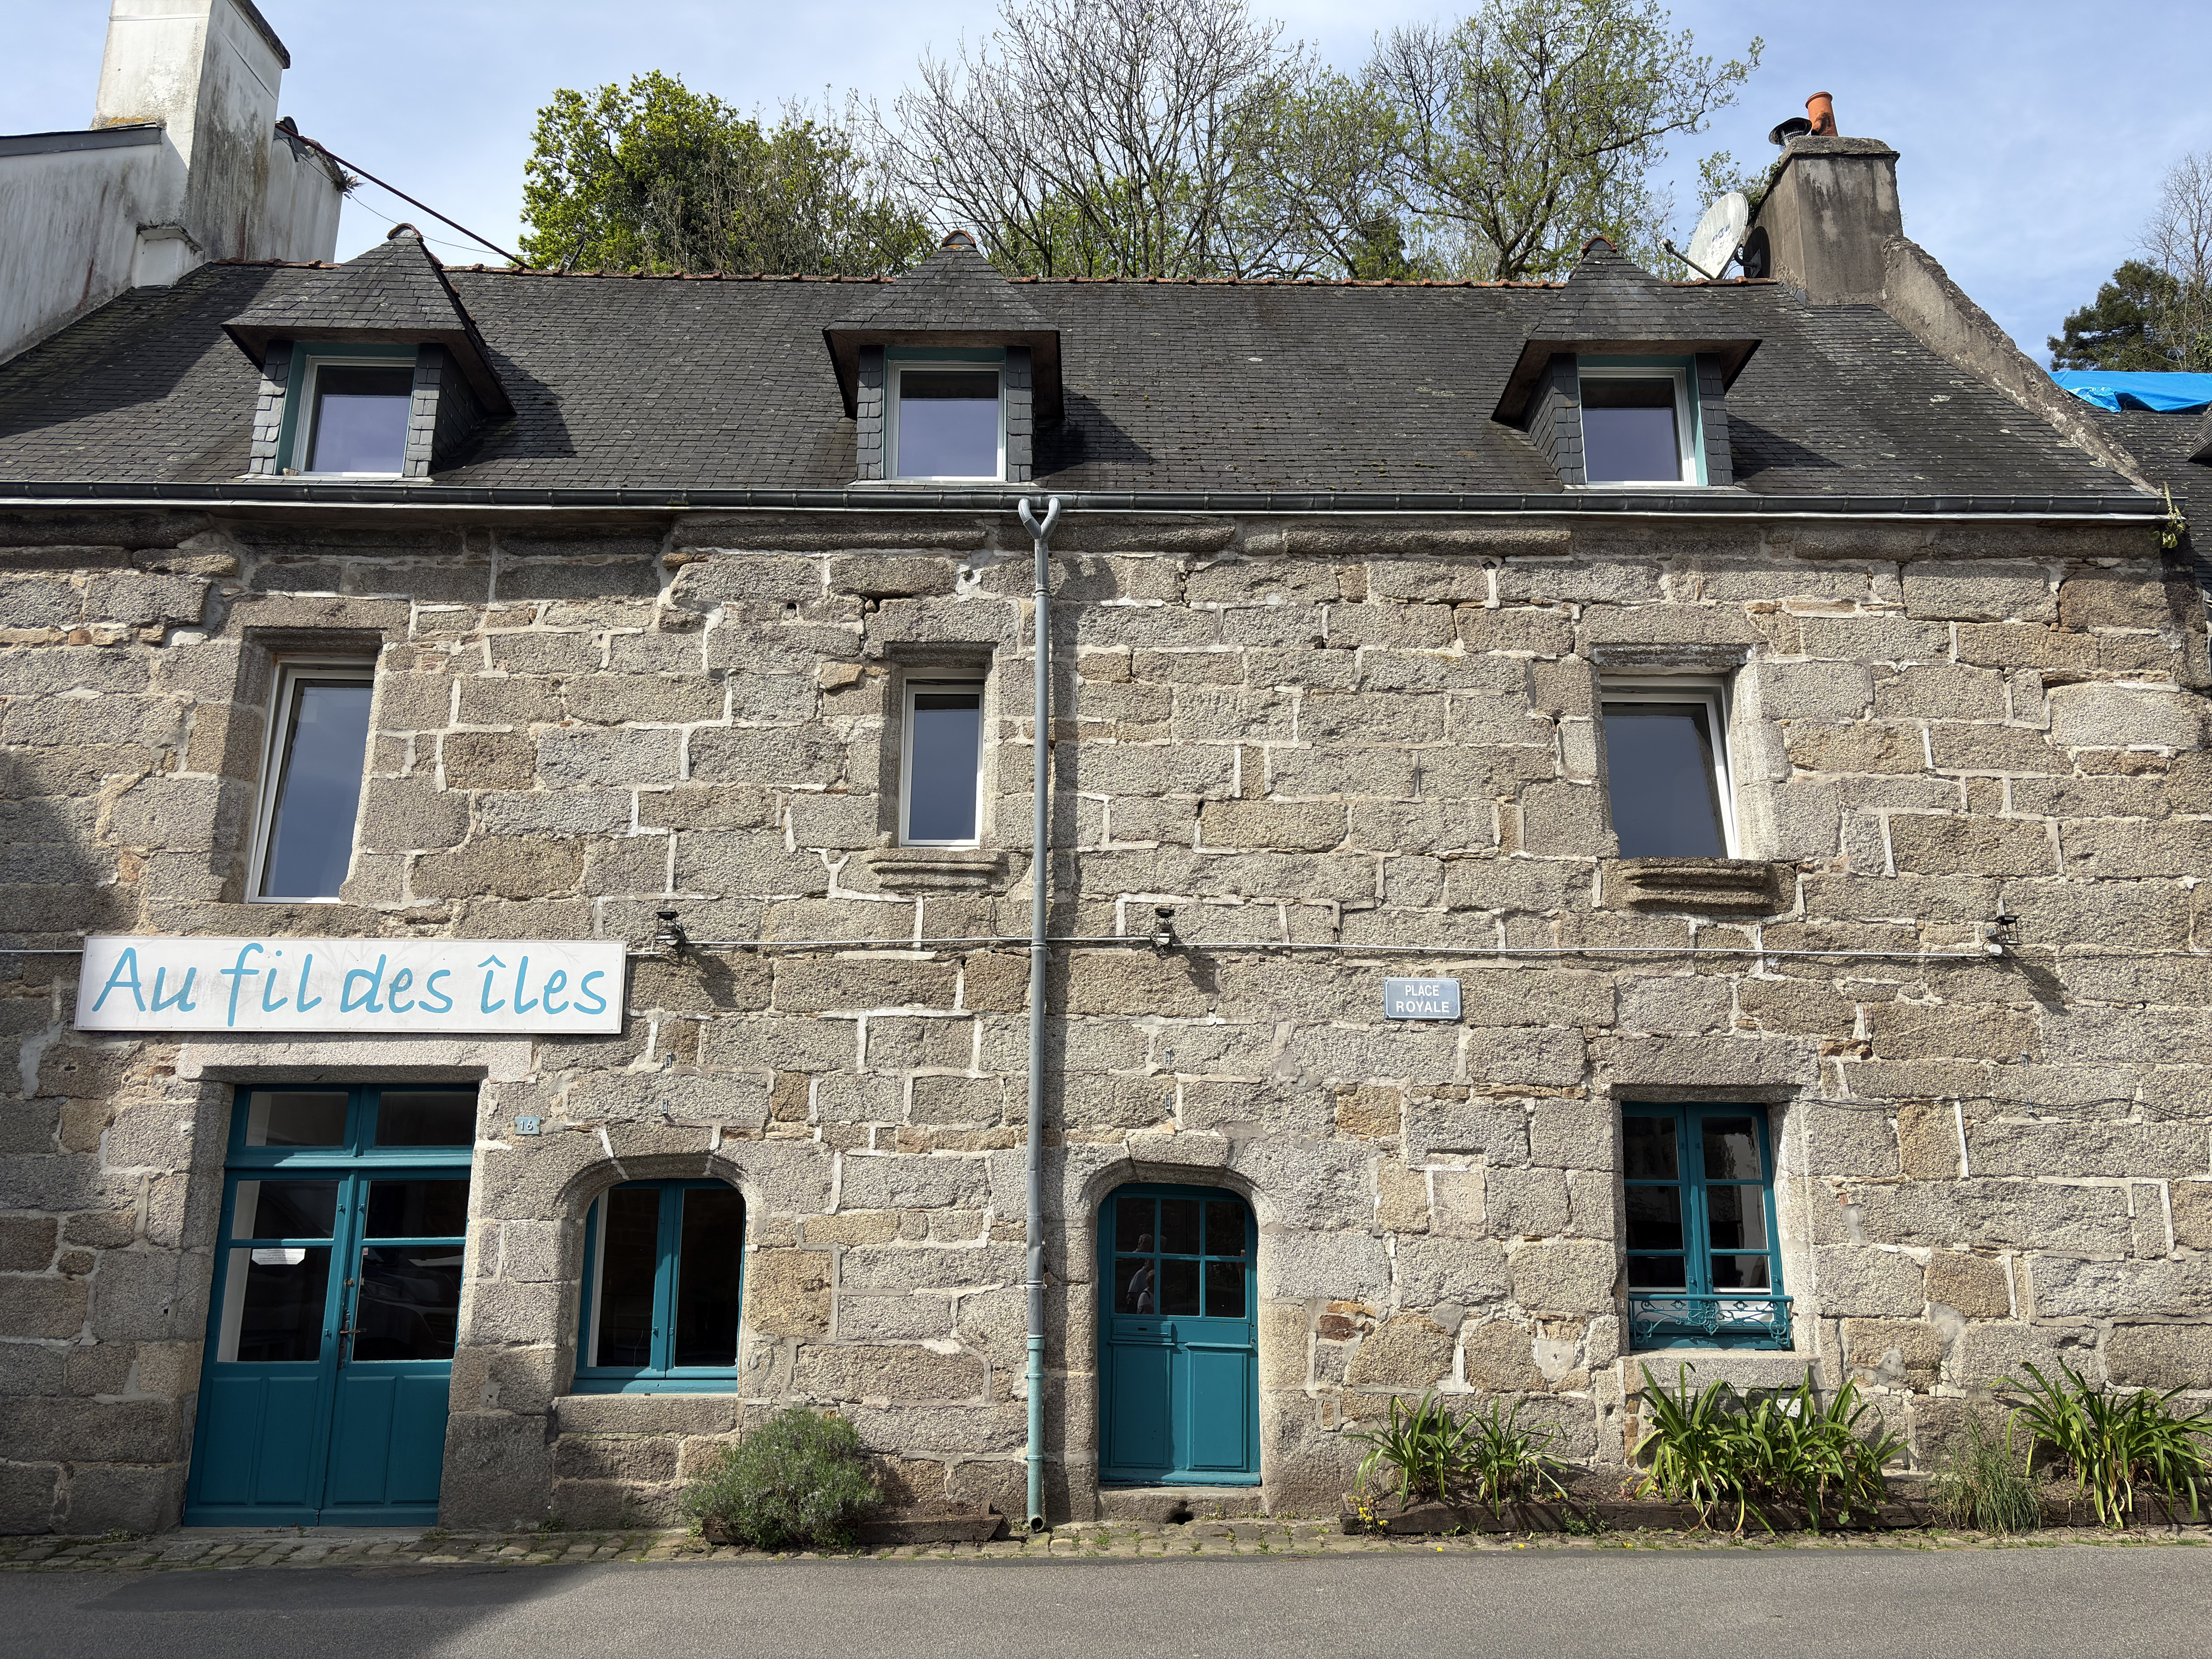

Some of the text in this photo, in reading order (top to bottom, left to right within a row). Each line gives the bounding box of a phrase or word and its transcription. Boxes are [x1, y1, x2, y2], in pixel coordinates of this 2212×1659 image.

[92, 942, 607, 1027] Au fil des îles
[1405, 984, 1439, 997] PLACE
[1396, 1001, 1449, 1013] ROYALE
[520, 1120, 533, 1130] 16
